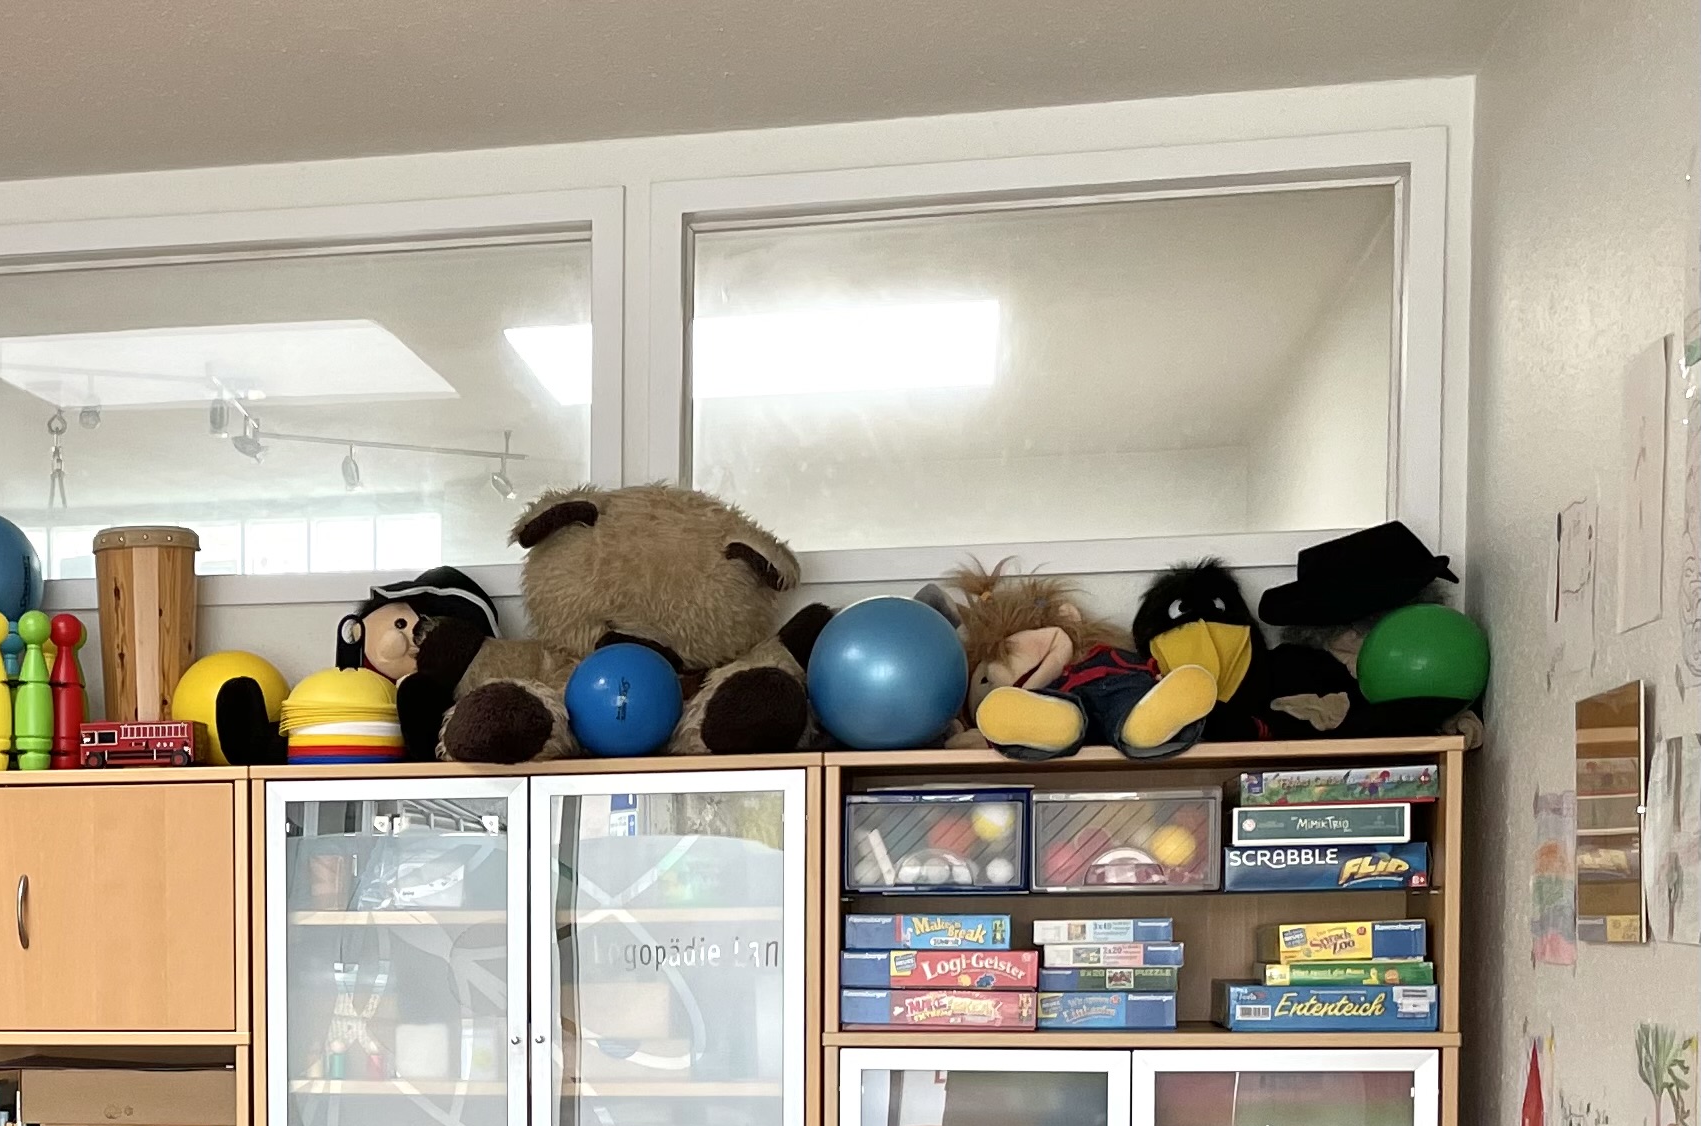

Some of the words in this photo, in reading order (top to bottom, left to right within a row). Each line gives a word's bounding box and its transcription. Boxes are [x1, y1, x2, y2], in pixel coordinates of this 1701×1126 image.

[1229, 848, 1339, 869] SCRABBLE
[947, 924, 987, 944] Break
[920, 952, 1026, 980] Logi-Geister
[1274, 992, 1386, 1017] Ententeich
